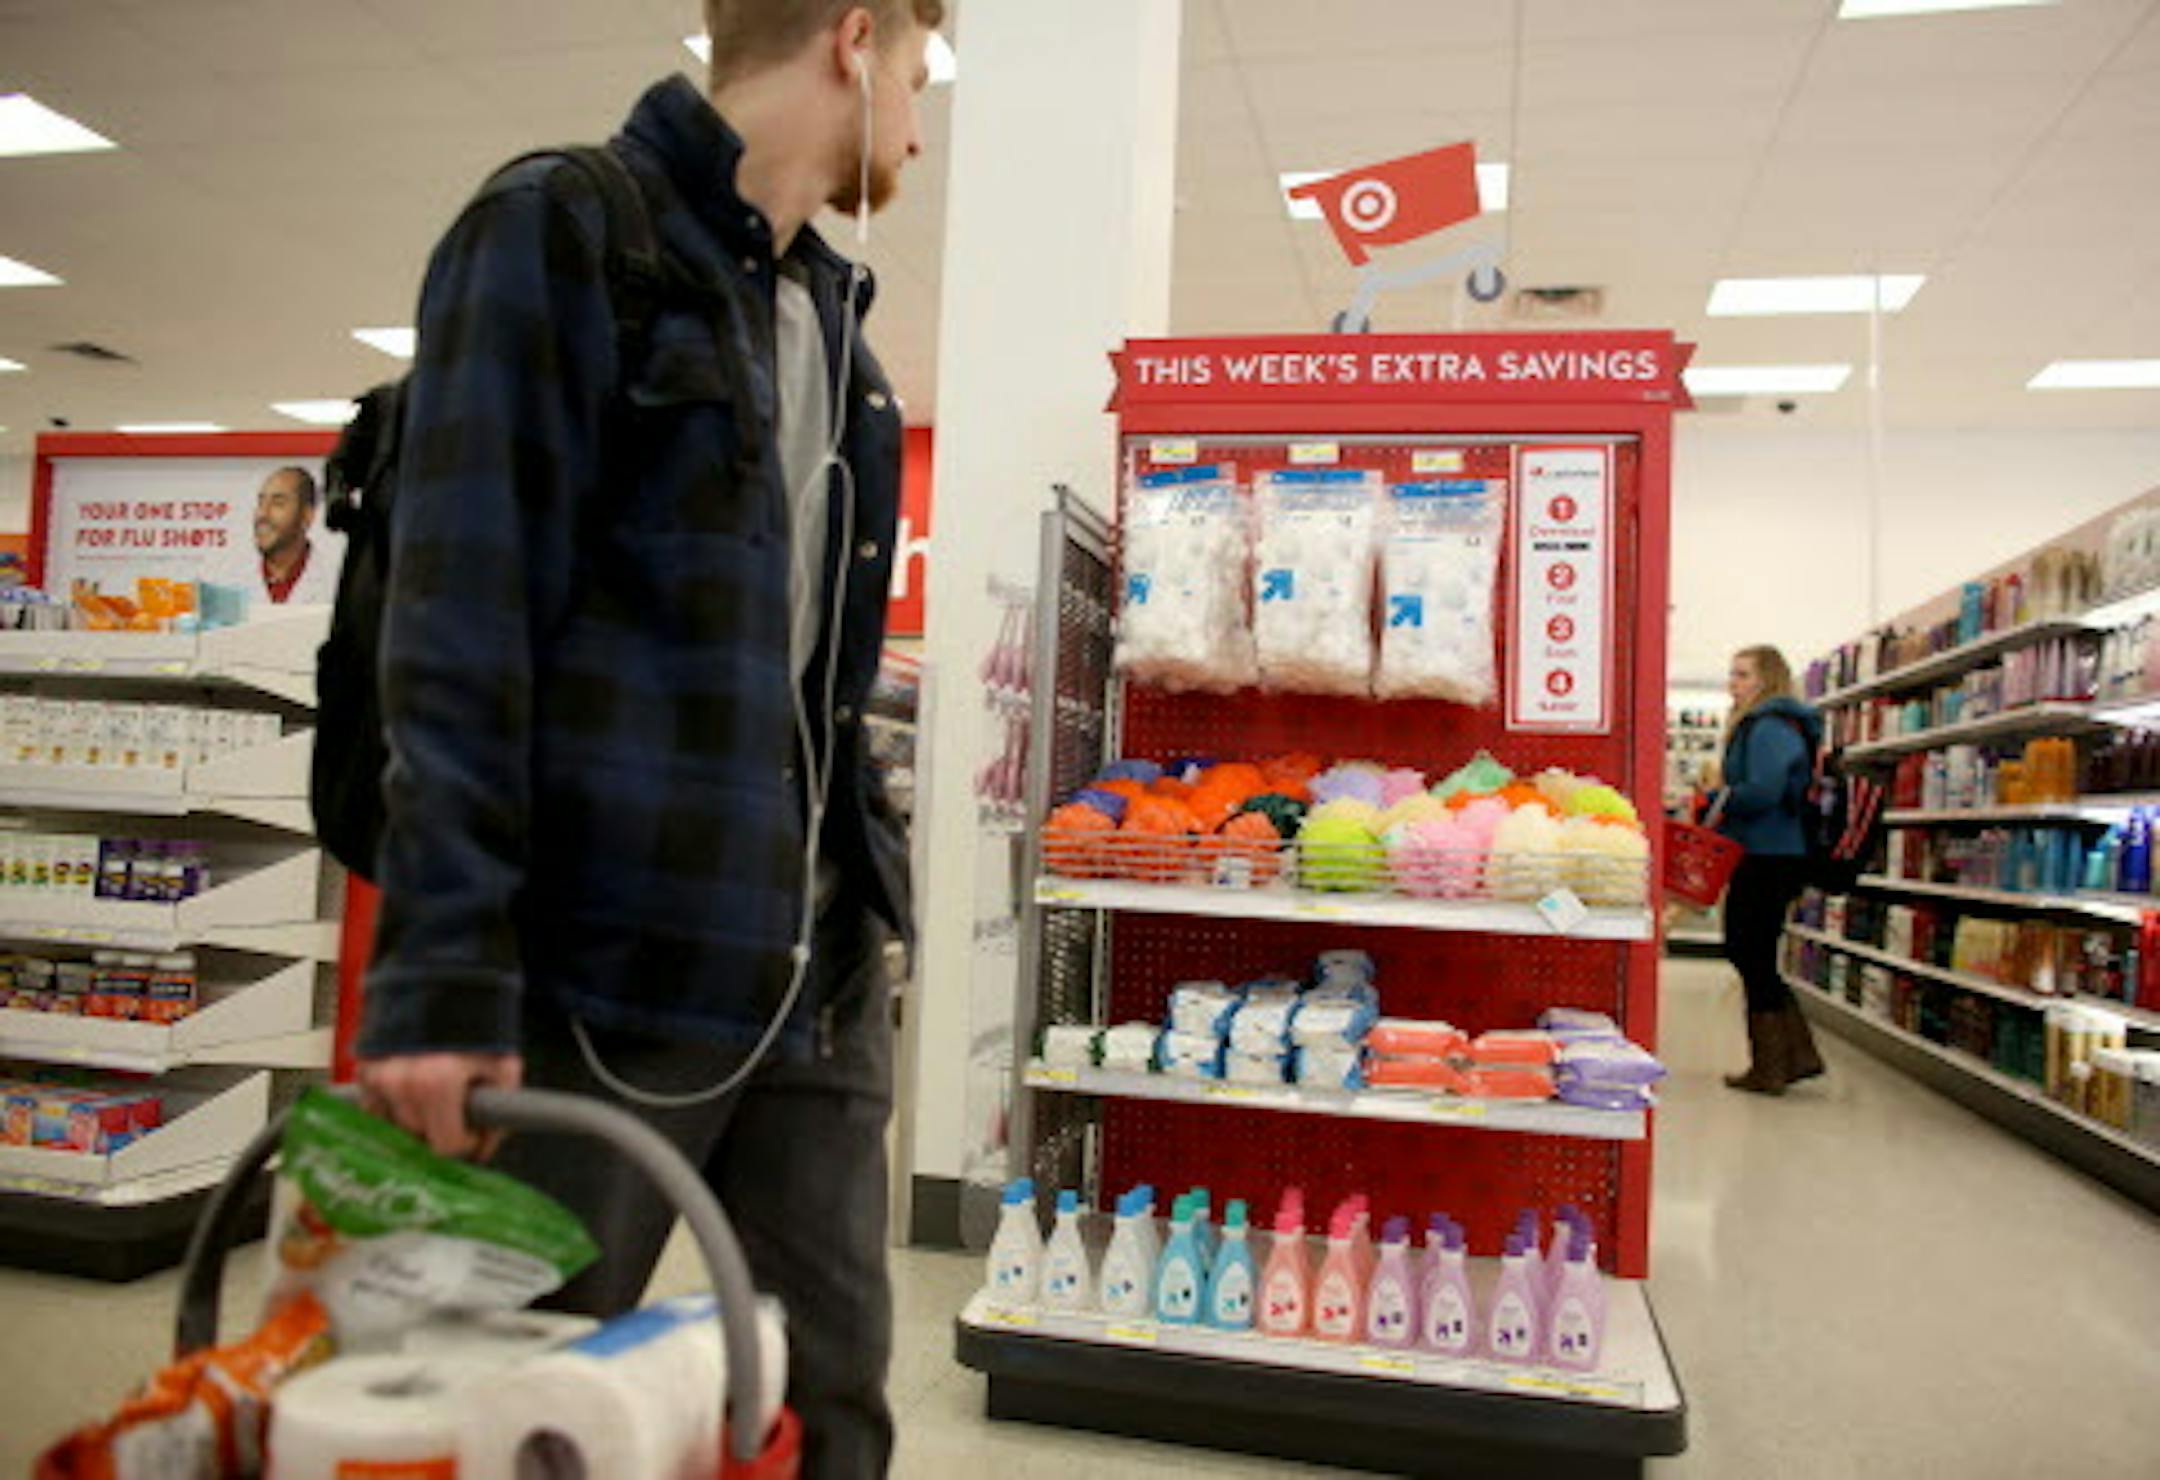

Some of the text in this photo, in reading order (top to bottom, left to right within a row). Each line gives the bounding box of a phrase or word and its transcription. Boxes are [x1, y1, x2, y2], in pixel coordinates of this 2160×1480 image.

[1134, 348, 1660, 386] THIS WEEK'S EXTRA SAVINGS
[78, 501, 230, 520] YOUR ONE STOP
[75, 528, 227, 547] FOR FLU SHOTS
